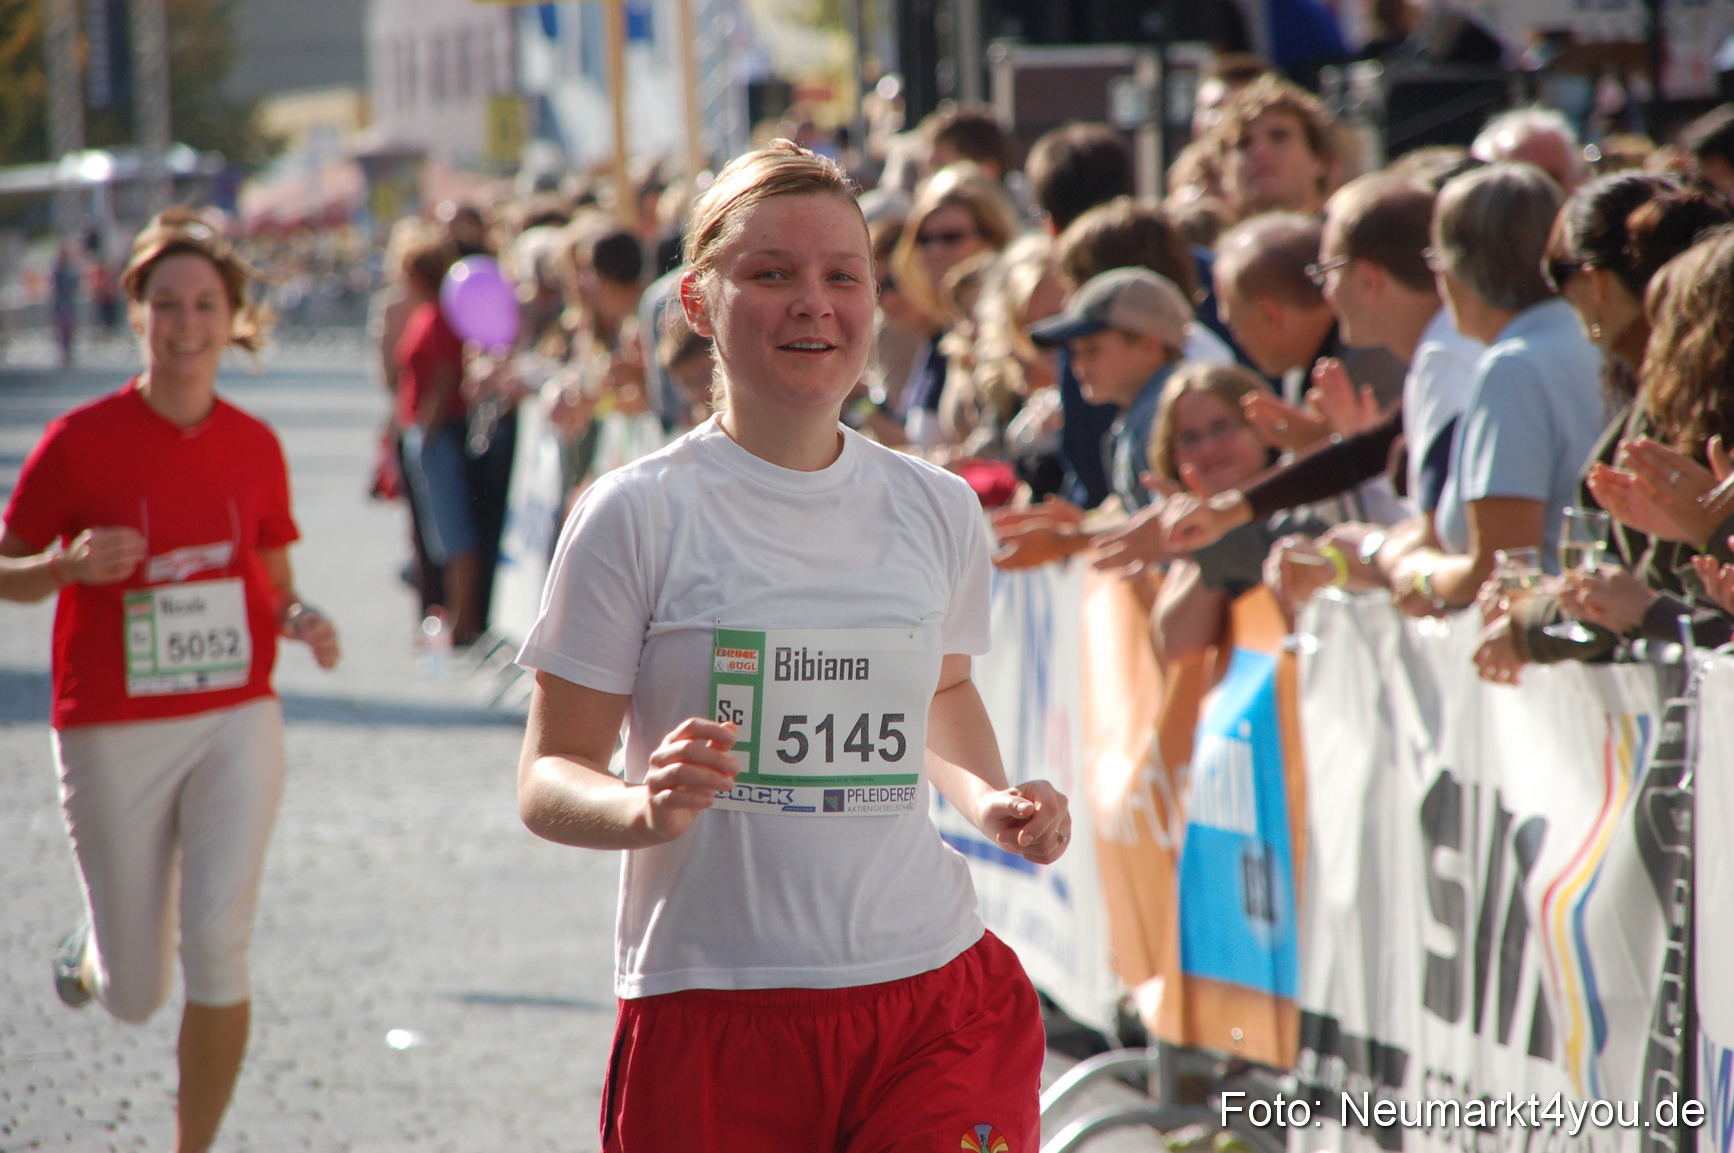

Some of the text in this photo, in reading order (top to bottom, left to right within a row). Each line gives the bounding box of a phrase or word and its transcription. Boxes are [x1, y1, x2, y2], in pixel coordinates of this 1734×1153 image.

[169, 627, 240, 663] 5052
[774, 647, 869, 682] Bibiana
[718, 700, 744, 726] Sc
[776, 713, 907, 764] 5145
[847, 787, 916, 803] PFLEIDERER
